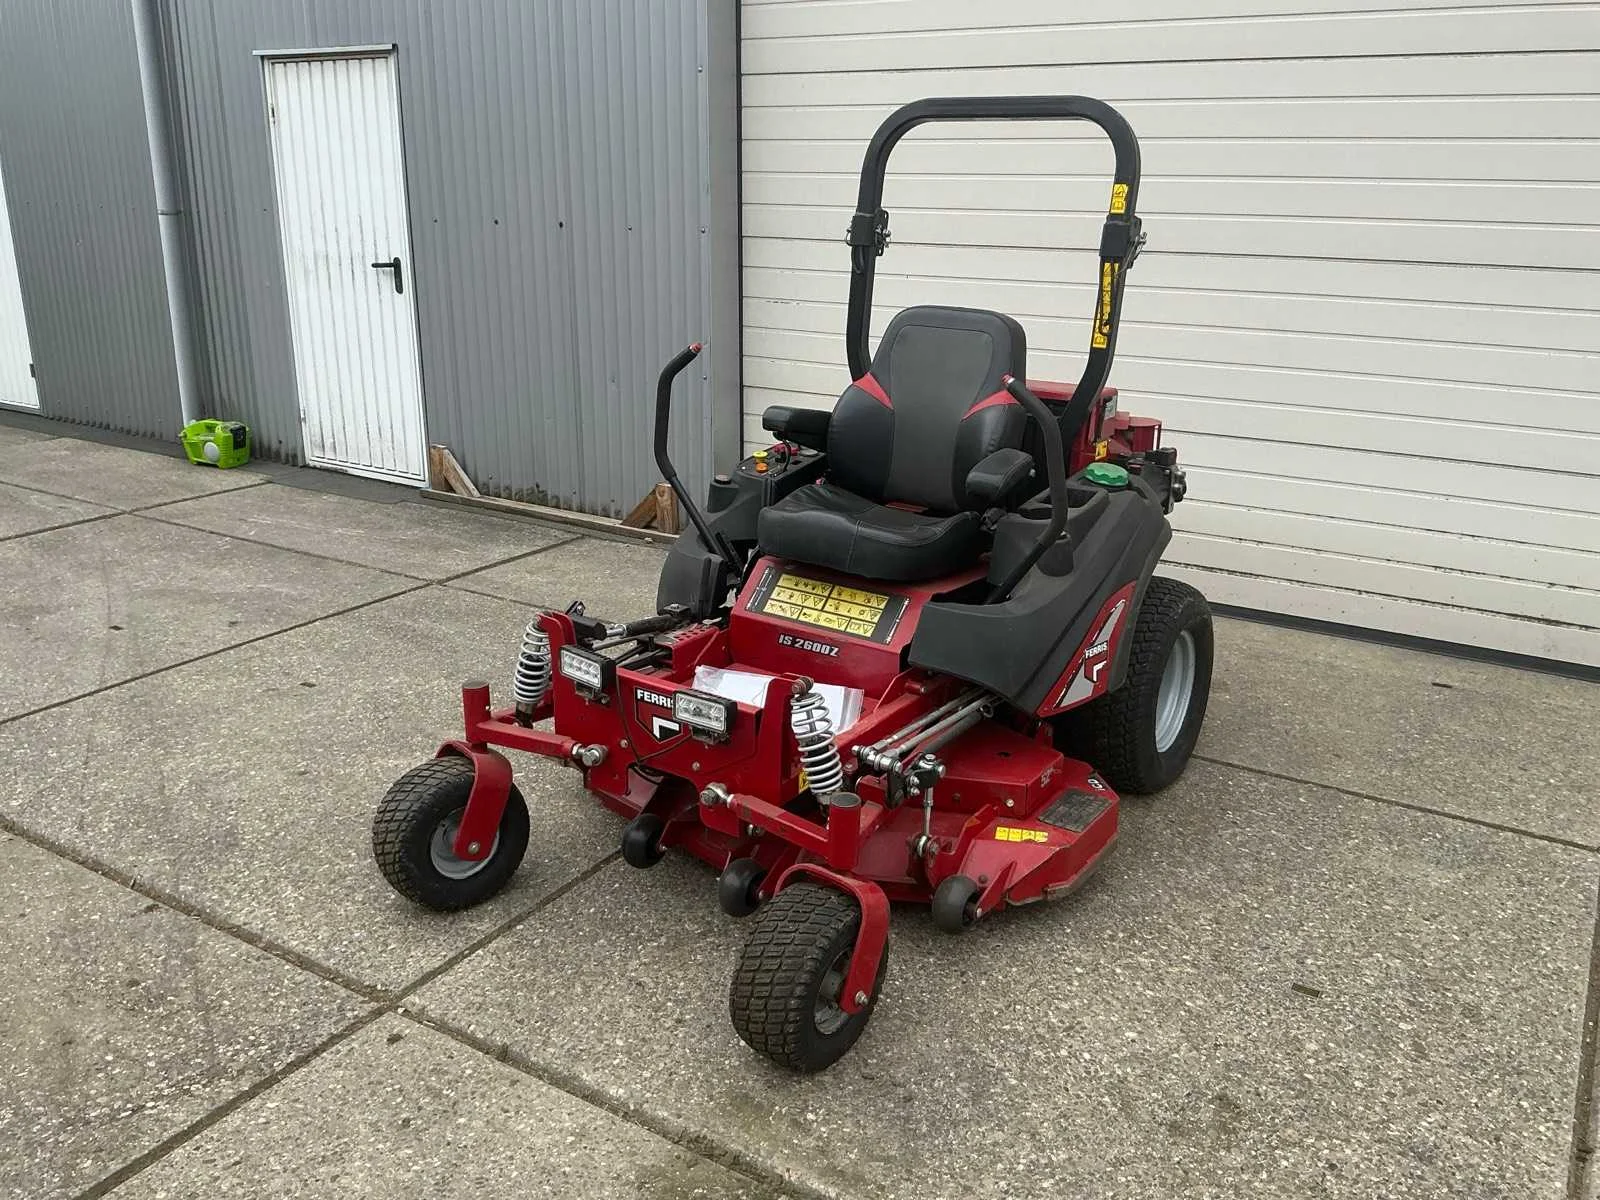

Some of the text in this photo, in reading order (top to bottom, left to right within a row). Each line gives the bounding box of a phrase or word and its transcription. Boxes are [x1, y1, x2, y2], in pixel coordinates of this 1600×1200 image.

[778, 634, 839, 656] IS 2600Z
[1085, 641, 1108, 659] FERRIS
[636, 689, 673, 708] FERRI
